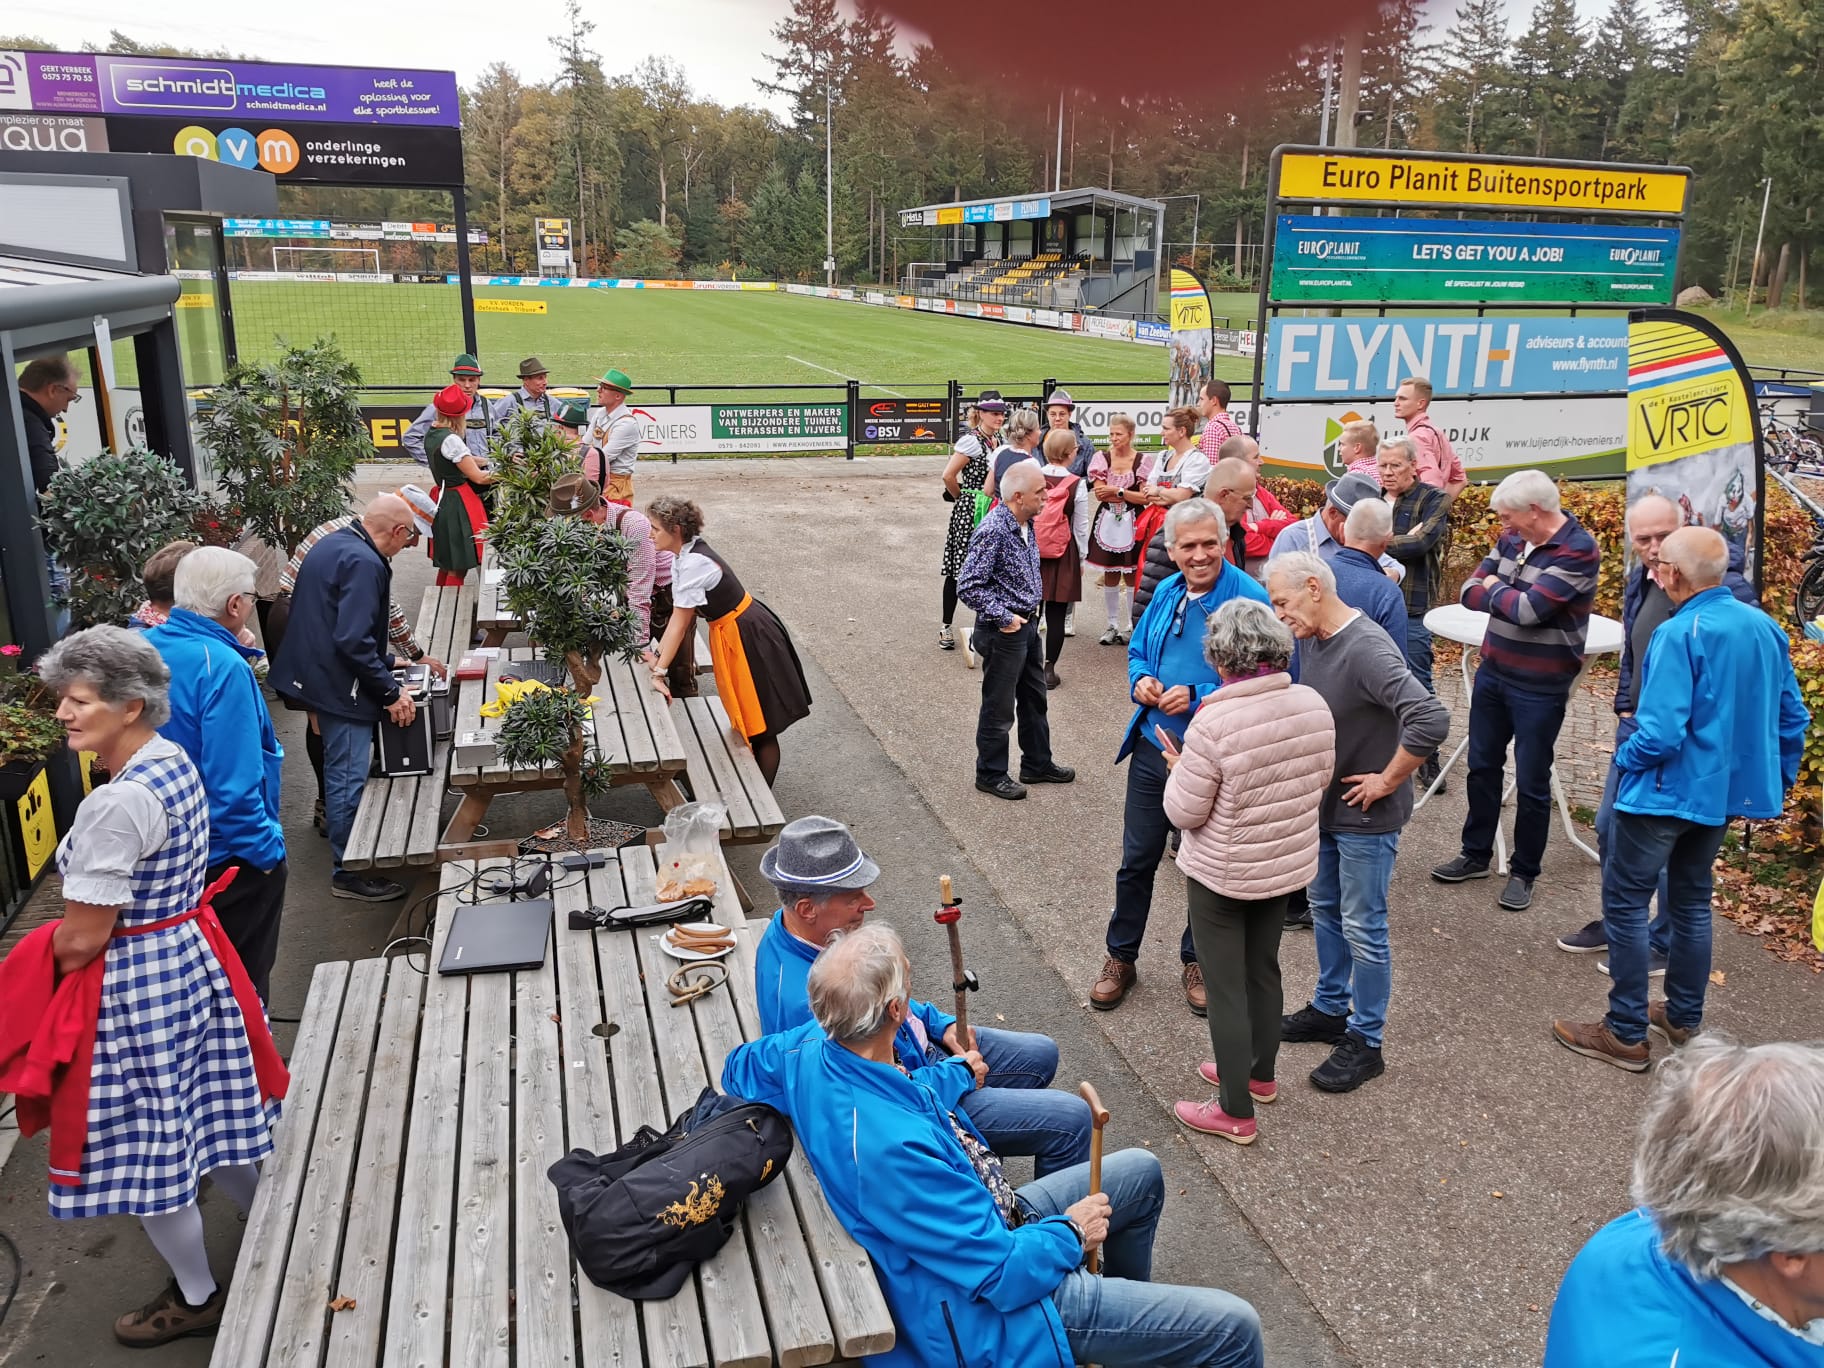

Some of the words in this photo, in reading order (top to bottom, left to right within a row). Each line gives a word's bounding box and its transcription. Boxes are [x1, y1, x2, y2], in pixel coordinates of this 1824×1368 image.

[40, 65, 58, 73] GERT
[60, 66, 92, 74] VERBEEK
[373, 78, 398, 88] heeft
[400, 79, 414, 88] de
[359, 93, 408, 104] oplossing
[246, 100, 327, 112] schmidtmedica.nl
[353, 107, 373, 115] elke
[375, 105, 440, 117] sportblessure!
[42, 118, 55, 126] op
[58, 118, 84, 126] maat
[306, 139, 381, 154] onderlinge
[307, 153, 406, 168] verzekeringen
[1322, 162, 1380, 189] Euro
[1389, 164, 1458, 193] Planit
[1466, 169, 1648, 205] Buitensportpark
[1298, 240, 1360, 259] EUROPLANIT
[1412, 244, 1453, 260] LET'S
[1455, 245, 1485, 260] GET
[1486, 246, 1517, 261] YOU
[1518, 247, 1529, 262] A
[1531, 247, 1564, 262] JOB!
[1609, 248, 1661, 265] EUROPLANIT
[1526, 336, 1575, 349] adviseurs
[1577, 336, 1585, 348] &
[1587, 336, 1629, 349] account
[1277, 323, 1521, 392] FLYNTH
[1552, 356, 1618, 372] www.flynth.nl
[719, 408, 786, 418] ONTWERPERS
[787, 408, 800, 417] EN
[803, 408, 842, 417] MAKERS
[718, 418, 738, 427] VAN
[741, 417, 801, 427] BIJZONDERE
[804, 416, 842, 426] TUINEN,
[1641, 392, 1728, 450] VRTC
[639, 424, 697, 440] VENIERS
[729, 426, 786, 436] TERRASSEN
[788, 426, 800, 435] EN
[804, 425, 842, 434] VIJVERS
[878, 426, 901, 438] BSV
[1505, 434, 1624, 451] www.luijendijk-hoveniers.nl
